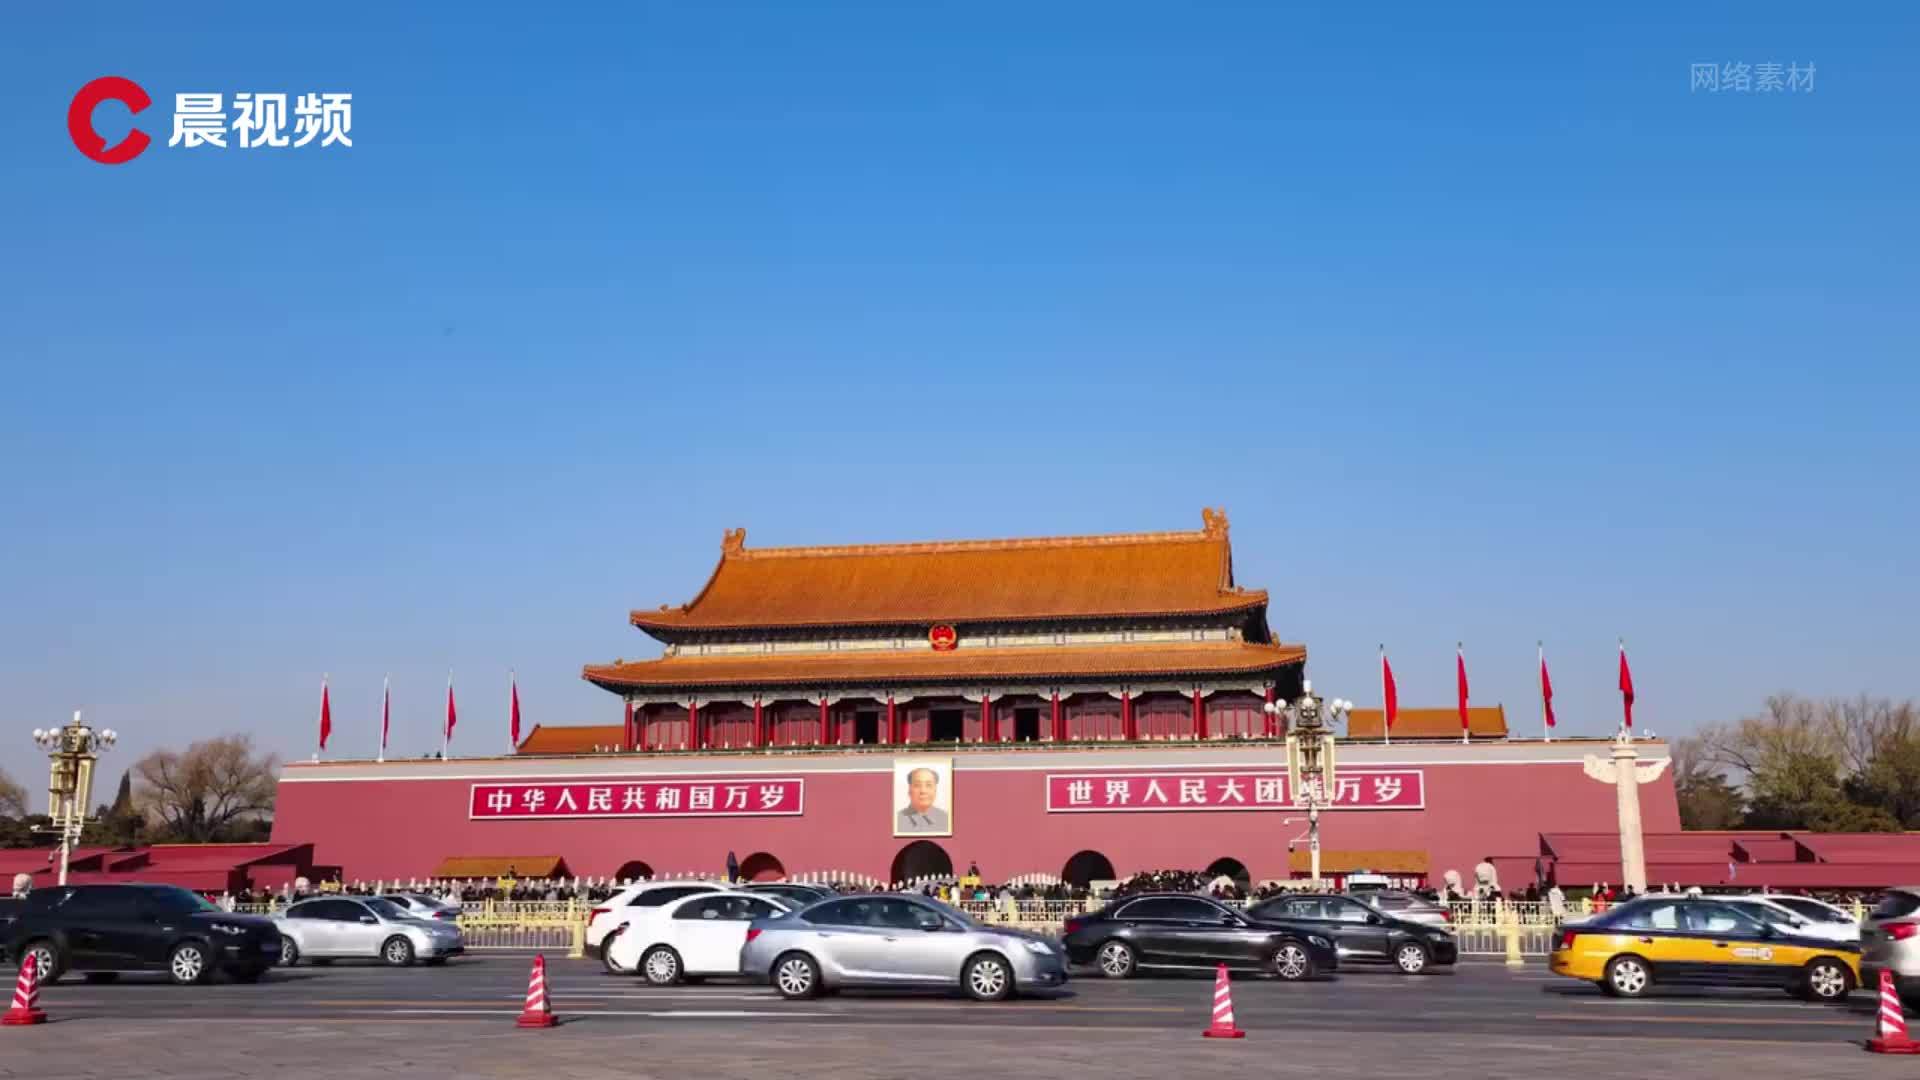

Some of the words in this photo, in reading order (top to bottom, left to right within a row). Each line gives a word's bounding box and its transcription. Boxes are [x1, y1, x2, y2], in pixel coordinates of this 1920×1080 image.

[487, 785, 786, 813] 中华人民共和国万岁
